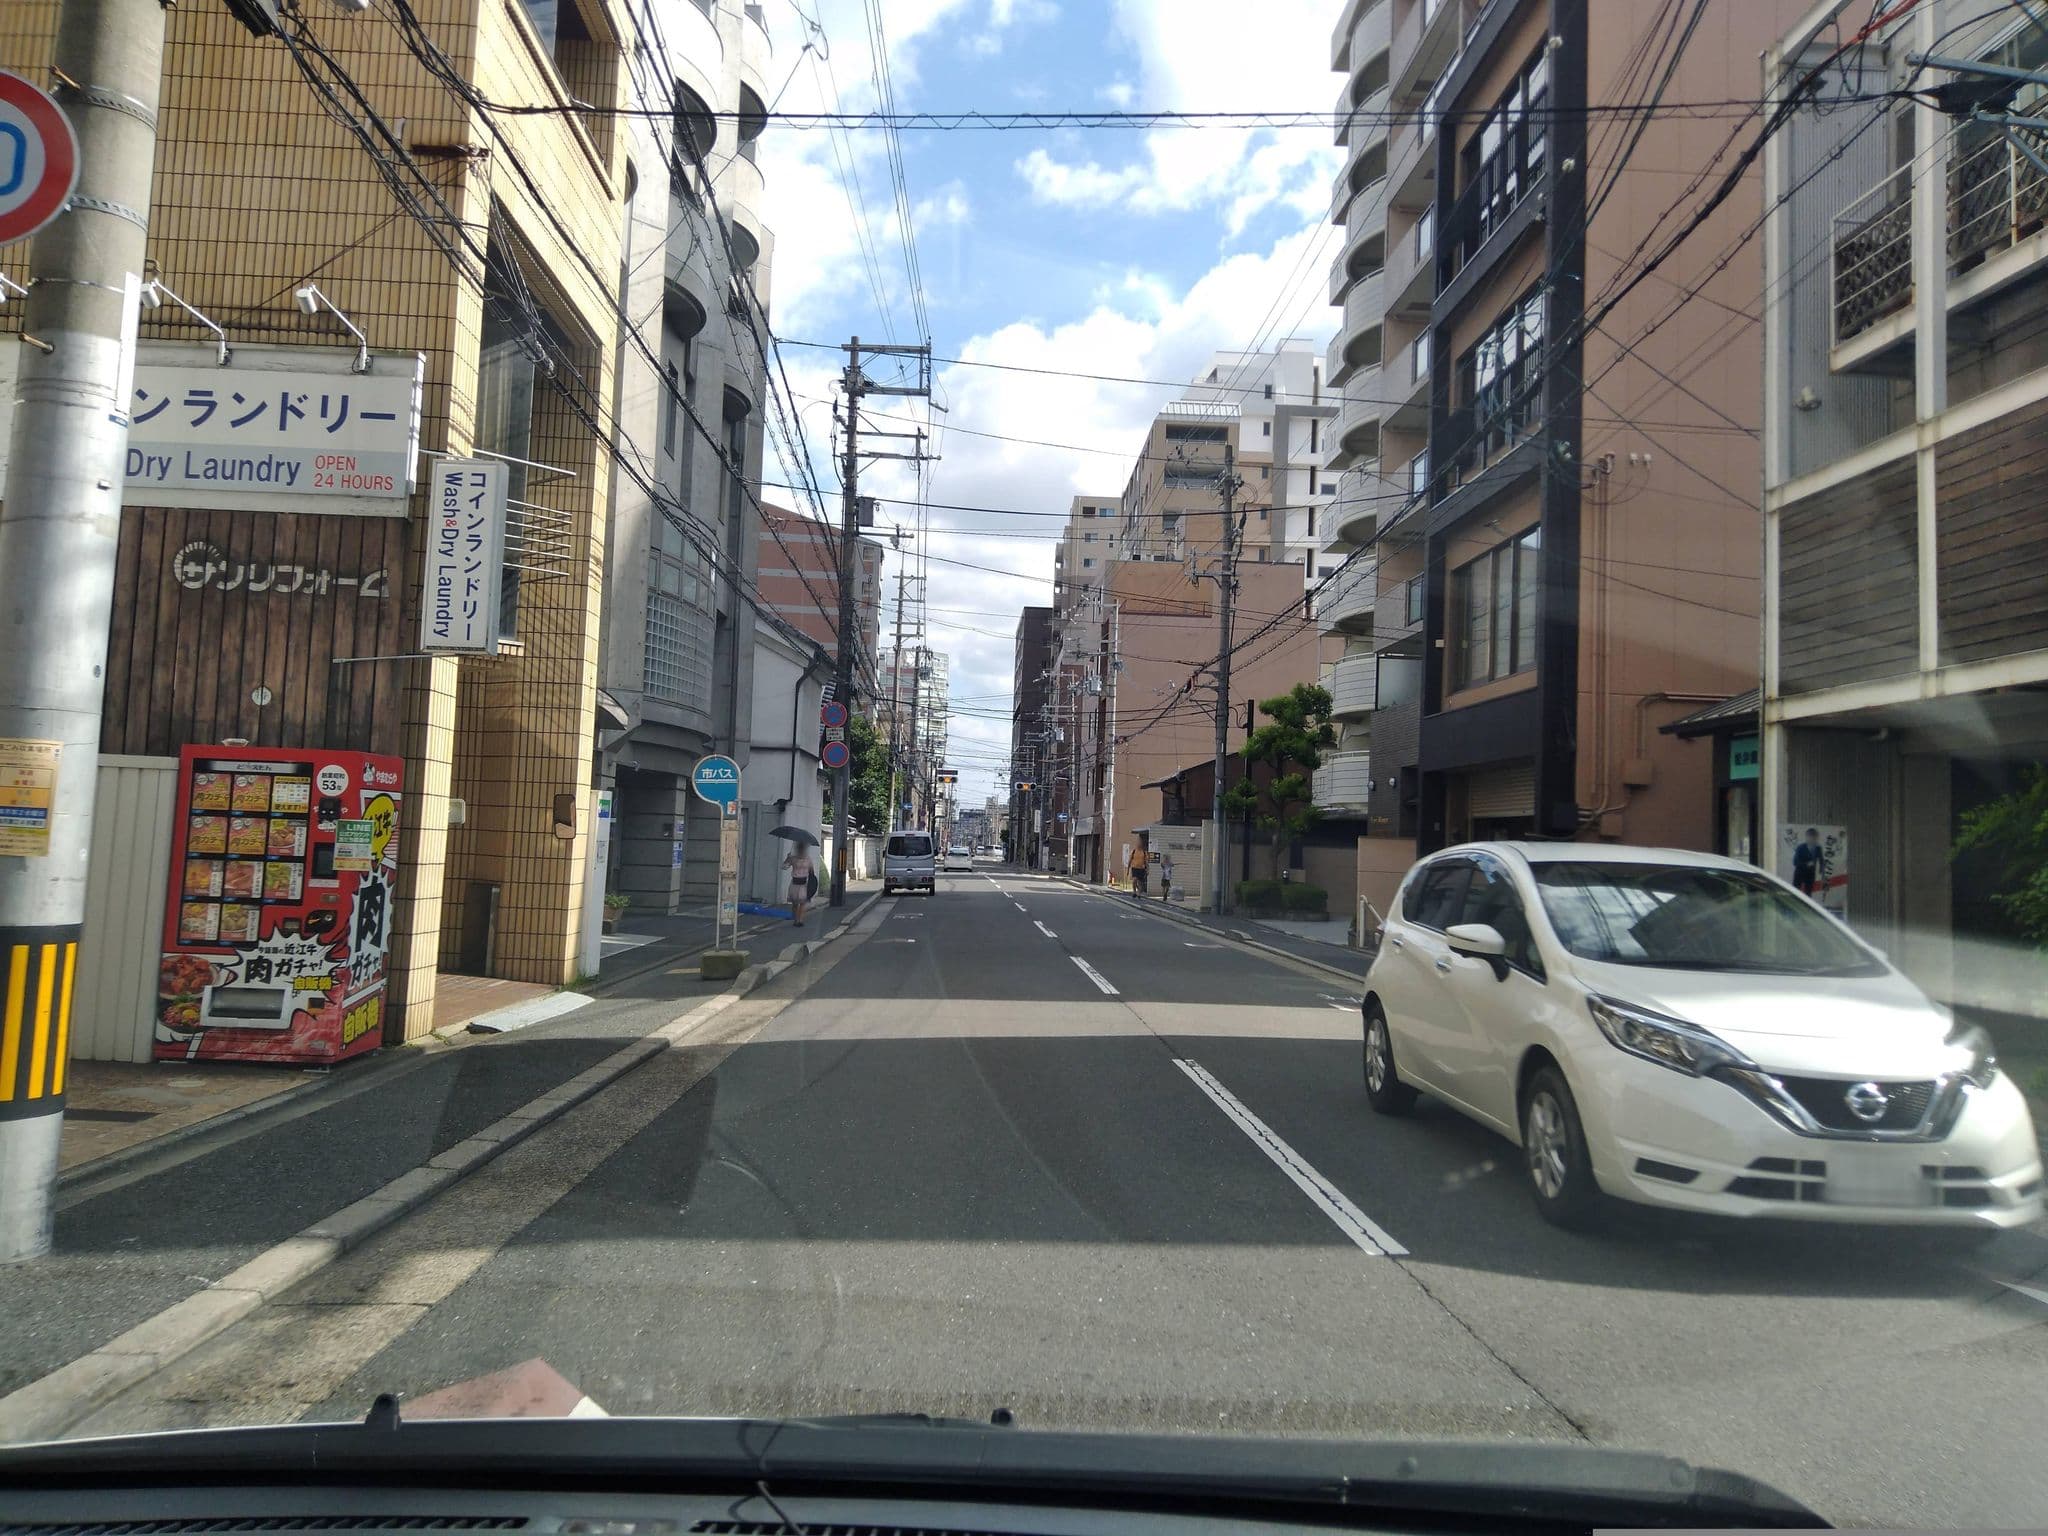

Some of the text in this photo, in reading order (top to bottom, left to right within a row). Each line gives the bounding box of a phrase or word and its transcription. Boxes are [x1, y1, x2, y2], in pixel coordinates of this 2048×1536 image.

[132, 388, 396, 434] ンランドリー
[126, 448, 301, 486] Dry Laundry
[313, 473, 393, 491] 24 HOURS
[314, 455, 356, 471] OPEN
[463, 472, 487, 641] コインランドリー
[433, 565, 458, 638] Laundry
[701, 768, 733, 779] 市バス
[346, 823, 371, 832] LINE
[355, 874, 386, 953] 肉
